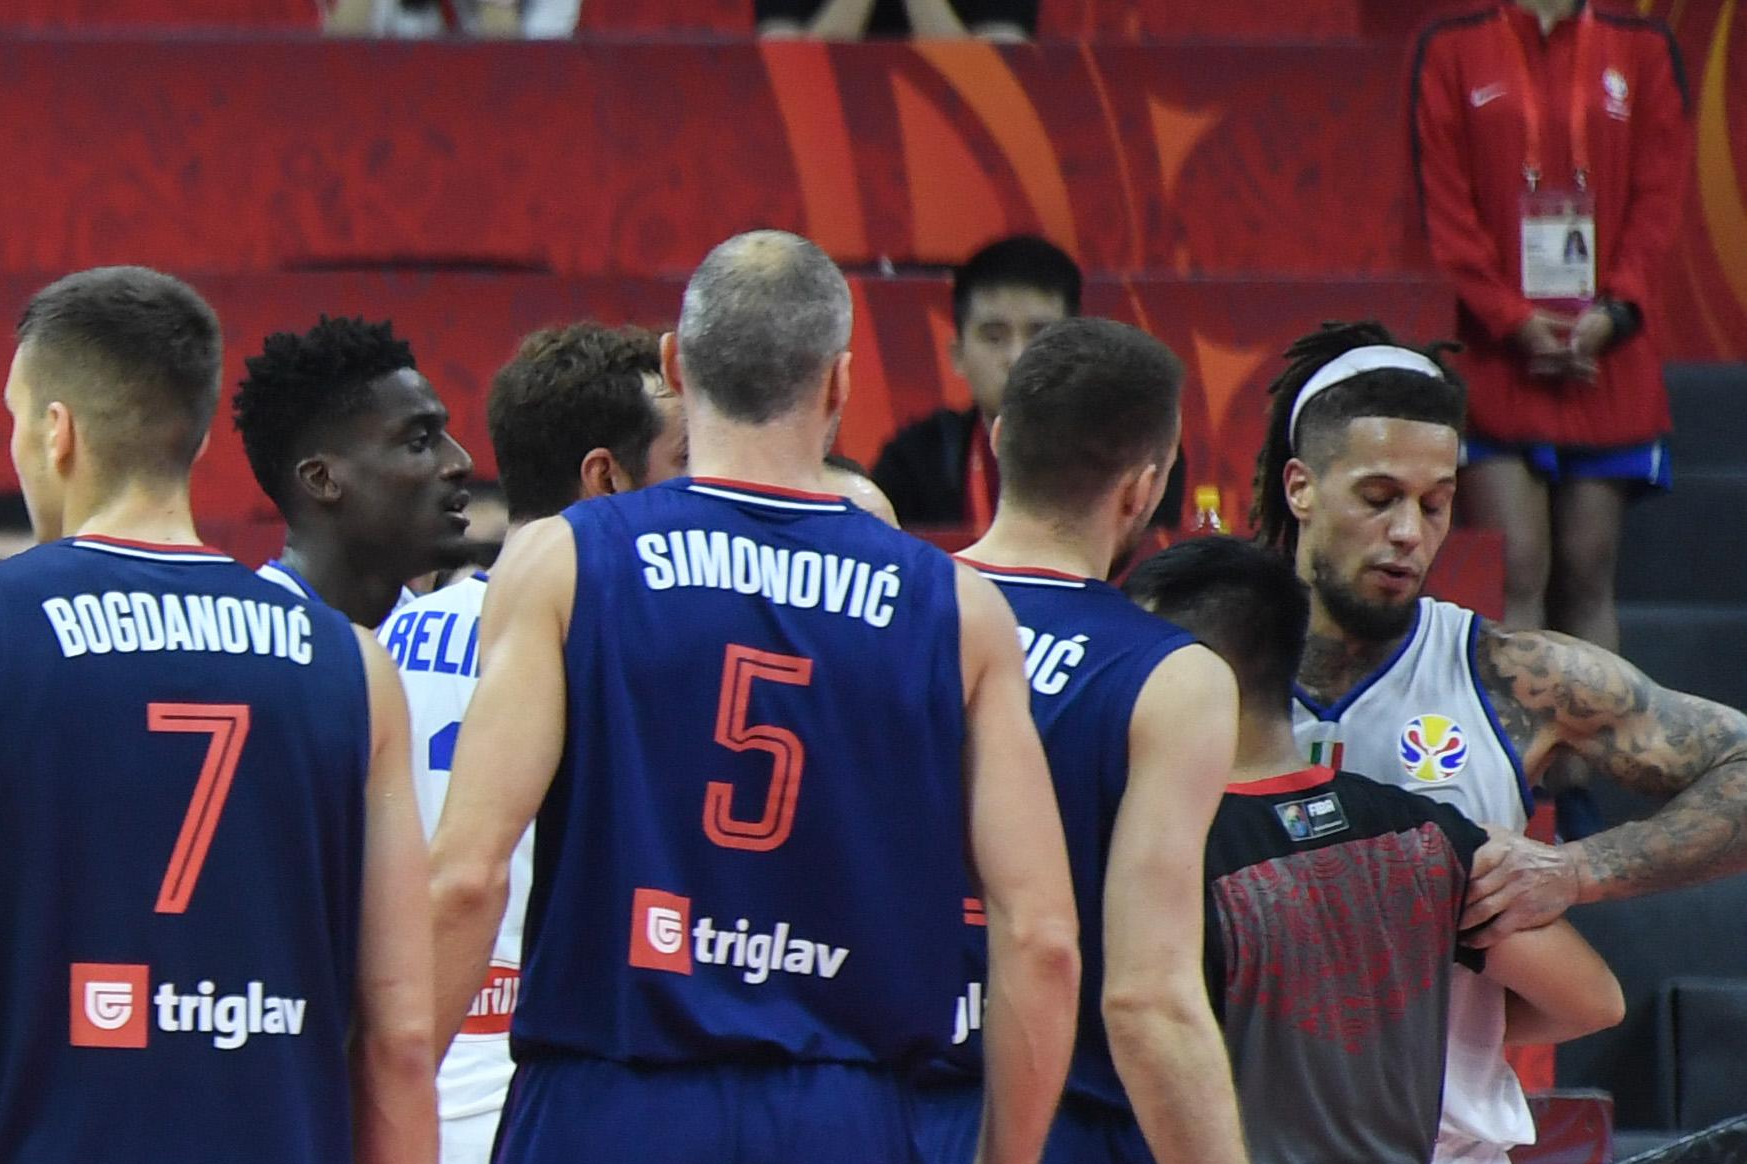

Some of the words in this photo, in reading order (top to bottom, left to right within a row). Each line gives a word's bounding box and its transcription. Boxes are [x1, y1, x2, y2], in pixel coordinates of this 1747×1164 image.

[635, 529, 901, 628] SIMONOVIĆ
[42, 591, 313, 665] BOGDANOVIĆ
[386, 610, 481, 678] BELI
[703, 643, 813, 852] 5
[147, 702, 251, 914] 7
[692, 917, 851, 985] triglav
[153, 980, 307, 1050] triglav
